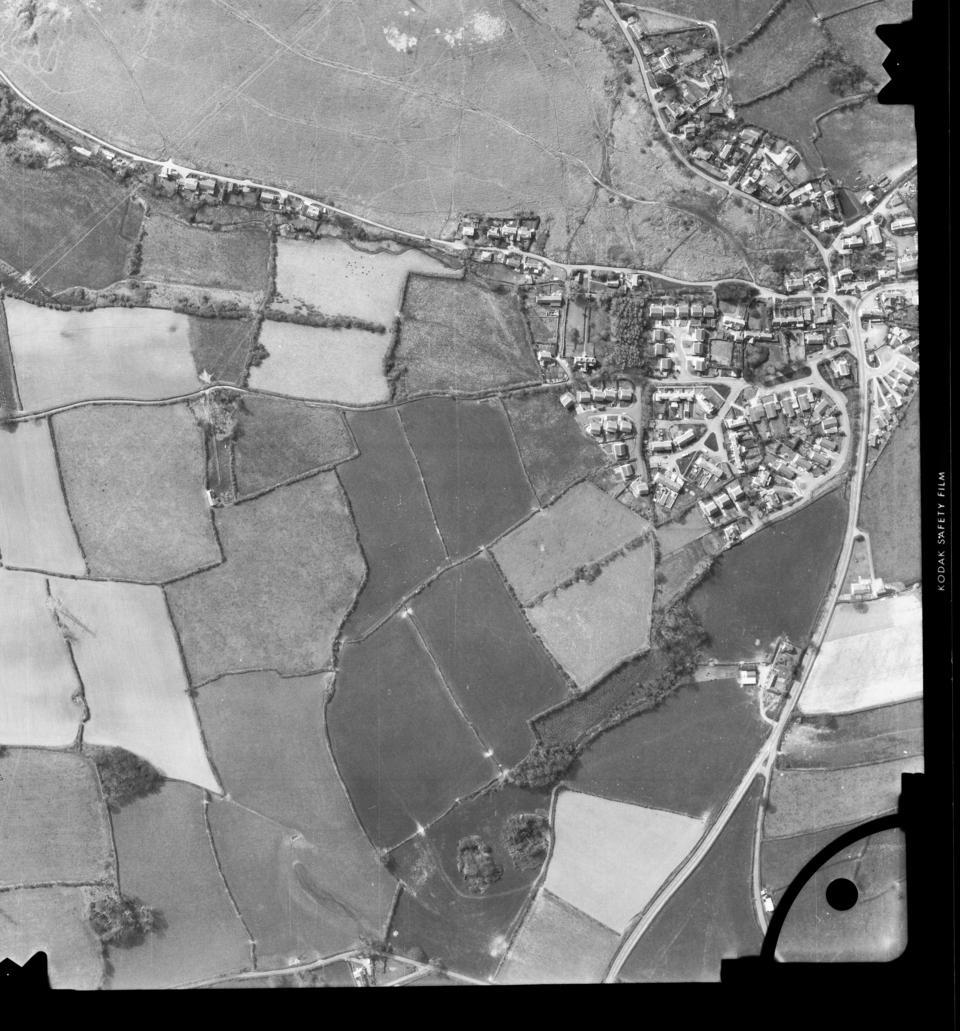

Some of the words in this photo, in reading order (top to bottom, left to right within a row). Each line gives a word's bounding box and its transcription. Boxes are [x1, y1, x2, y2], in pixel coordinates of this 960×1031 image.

[937, 471, 946, 497] FILM
[937, 503, 946, 545] SAFETY
[937, 551, 946, 591] KODAK
